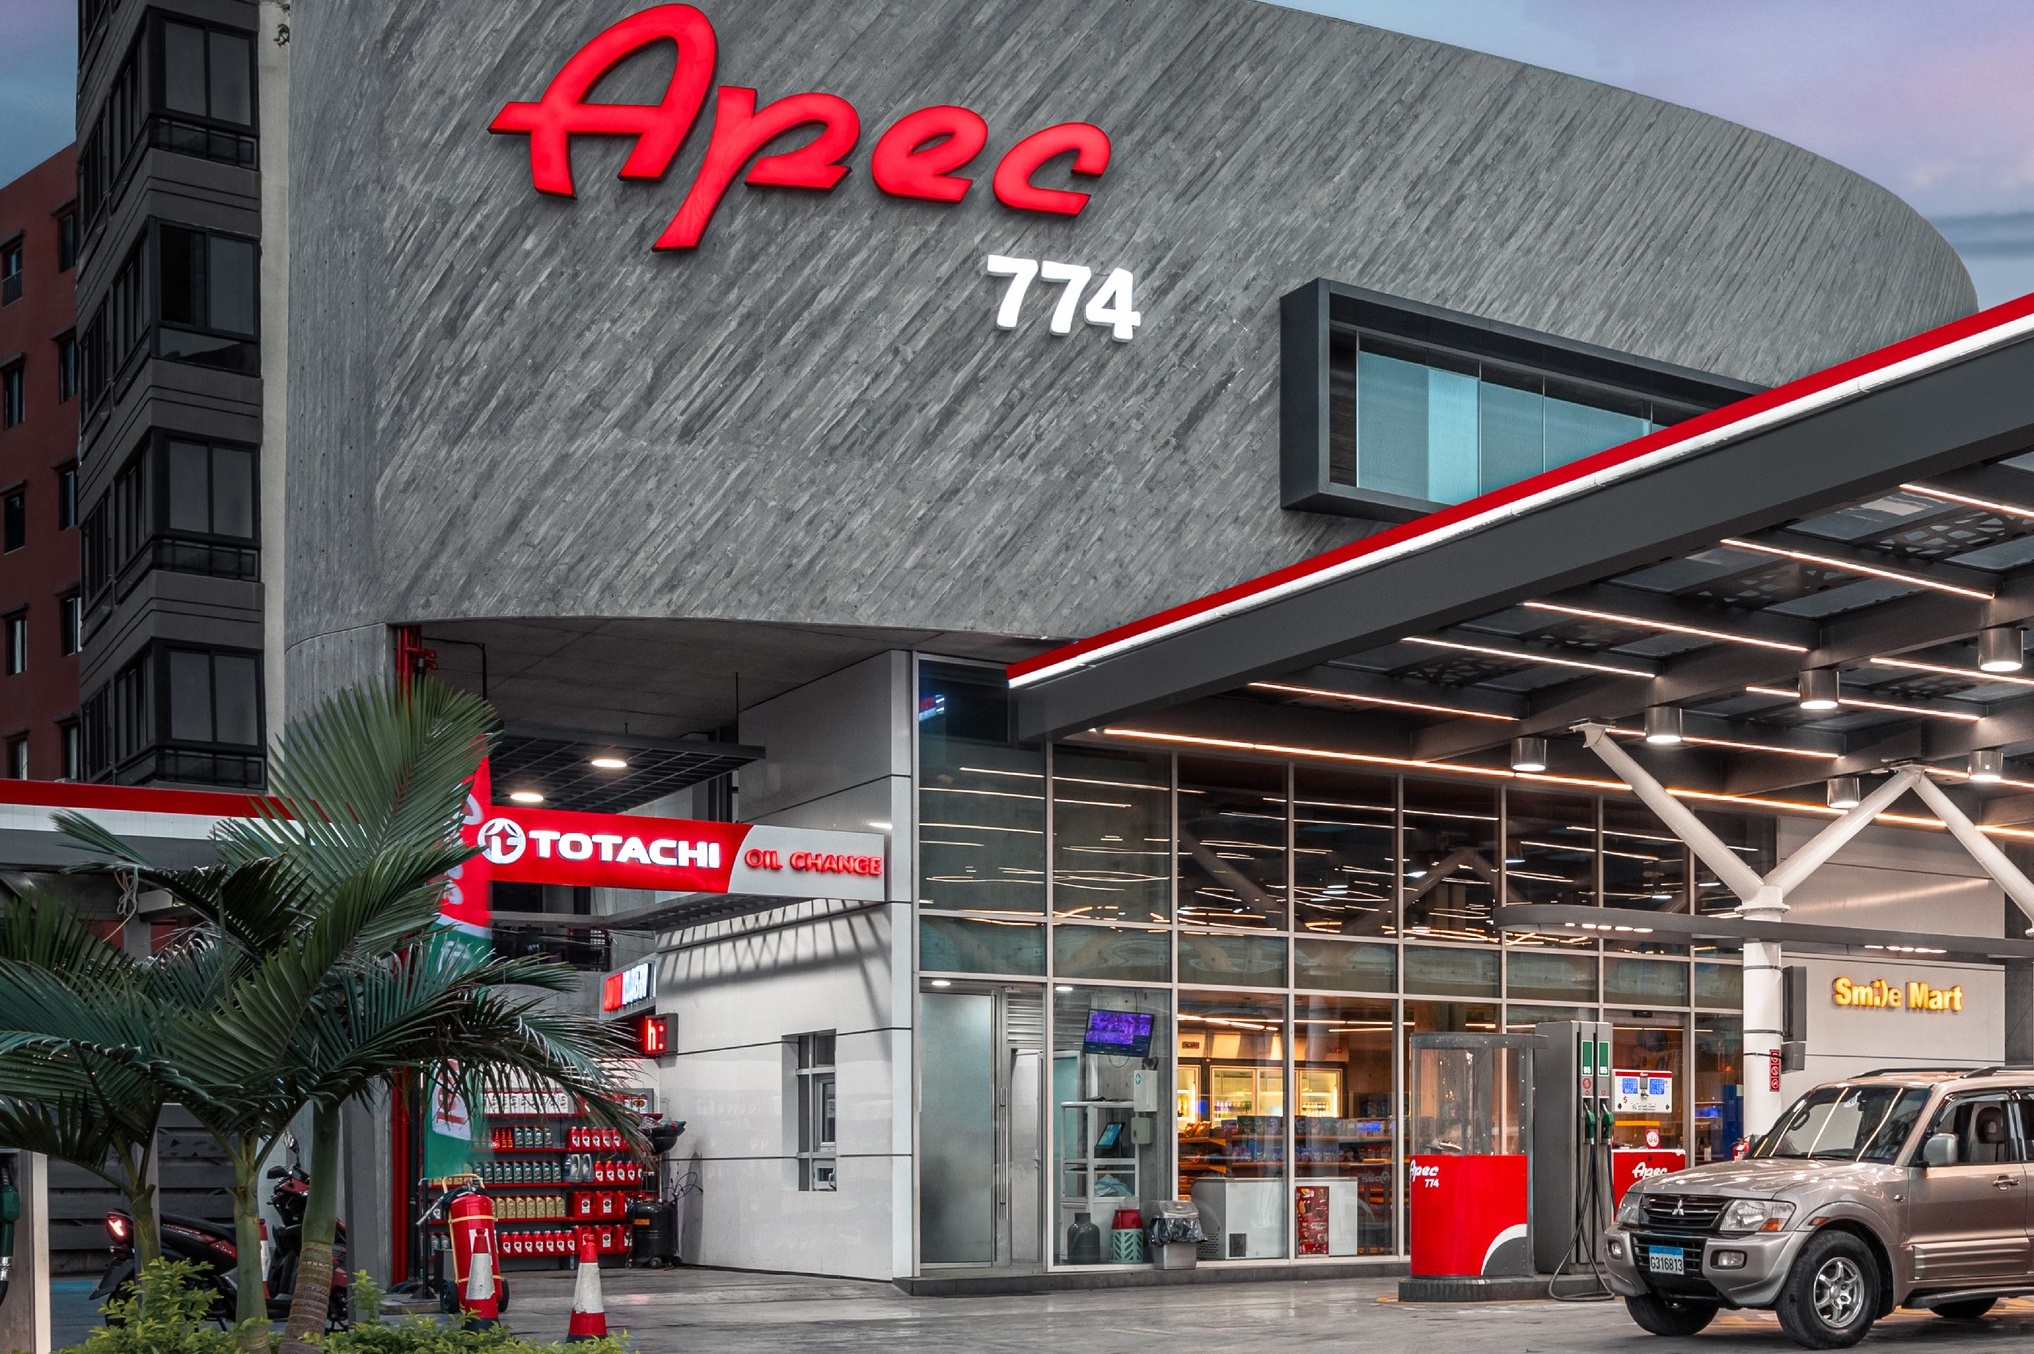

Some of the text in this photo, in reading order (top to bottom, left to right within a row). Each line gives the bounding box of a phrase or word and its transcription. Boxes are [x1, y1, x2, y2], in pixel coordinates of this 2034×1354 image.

[487, 3, 1113, 252] Apec
[985, 253, 1142, 342] 774
[529, 829, 721, 868] TOTACHI
[745, 848, 883, 877] OIL CHANGE
[1905, 981, 1963, 1011] Mart
[1410, 1159, 1440, 1182] Apec
[1424, 1178, 1440, 1188] 774
